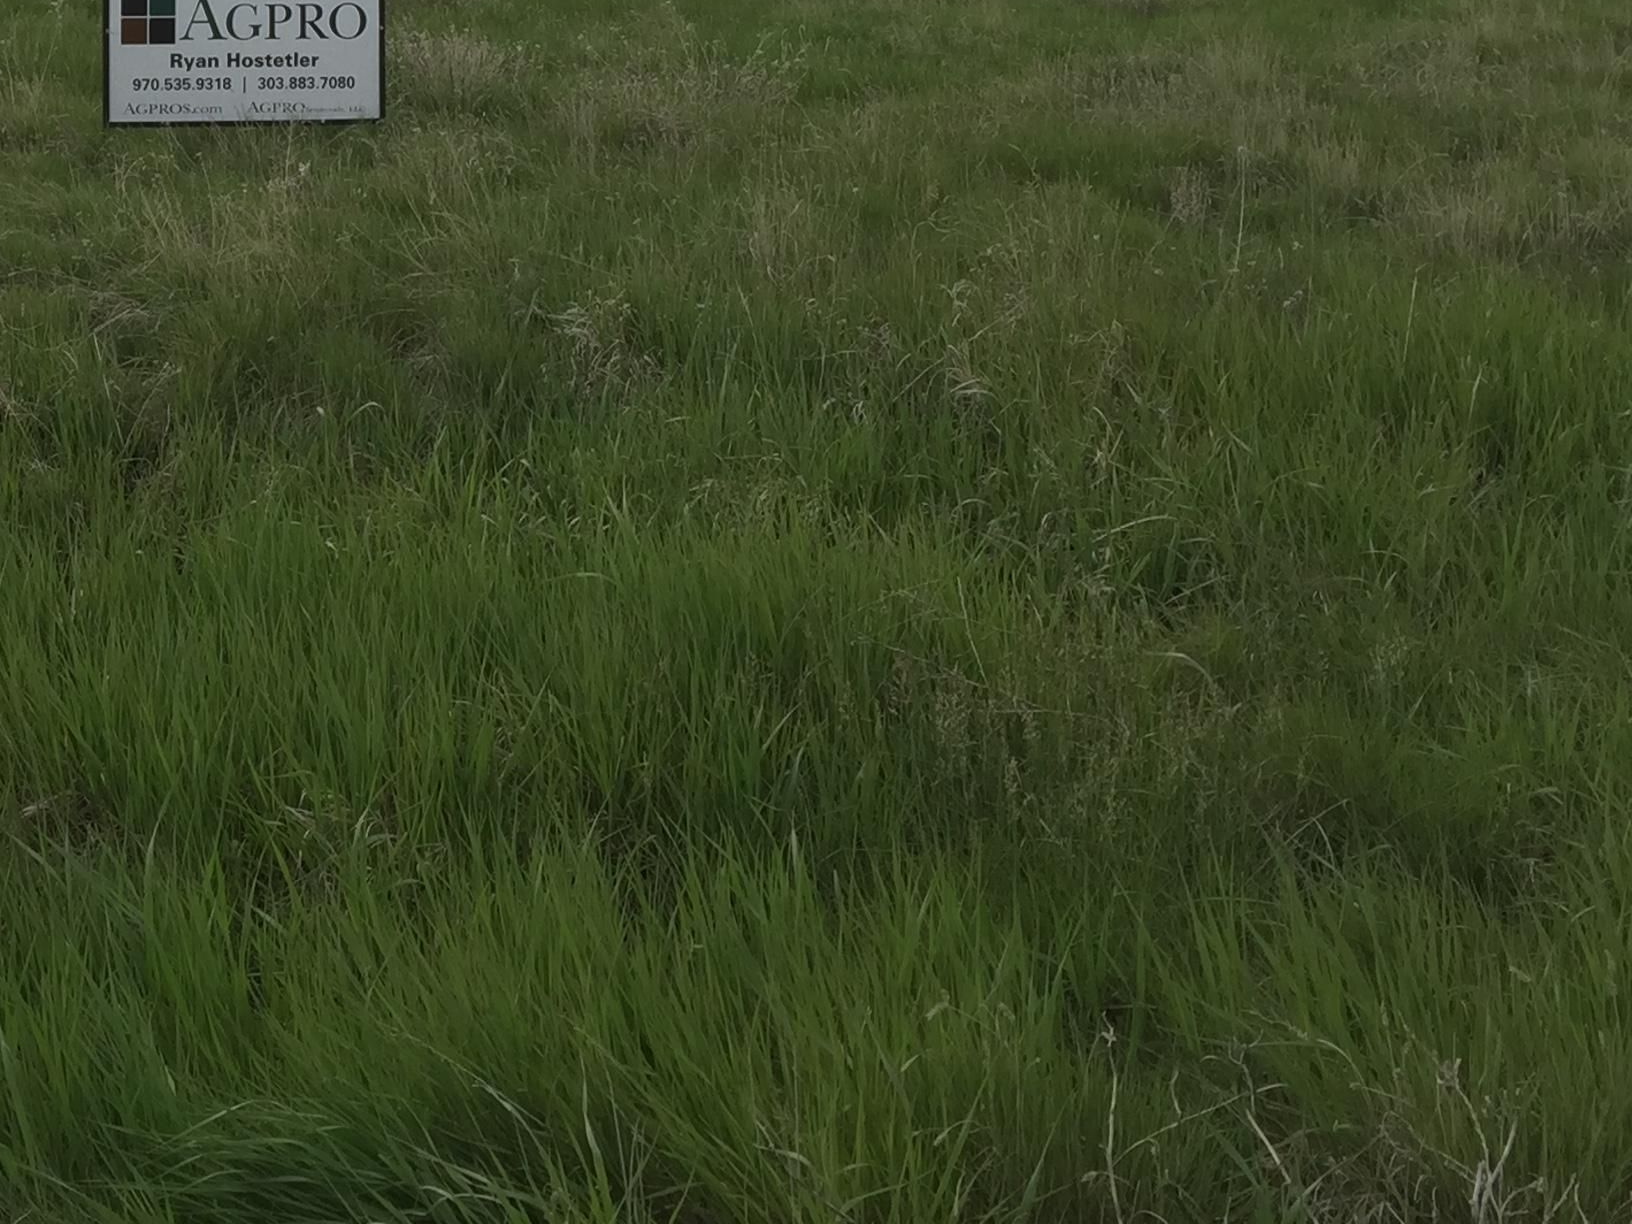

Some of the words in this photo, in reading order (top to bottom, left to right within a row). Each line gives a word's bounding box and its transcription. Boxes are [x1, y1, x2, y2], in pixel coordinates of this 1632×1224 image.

[169, 53, 219, 72] Ryan
[226, 52, 320, 69] Hostetler
[132, 77, 233, 92] 970.535.9318
[257, 76, 356, 91] 303.883.7080
